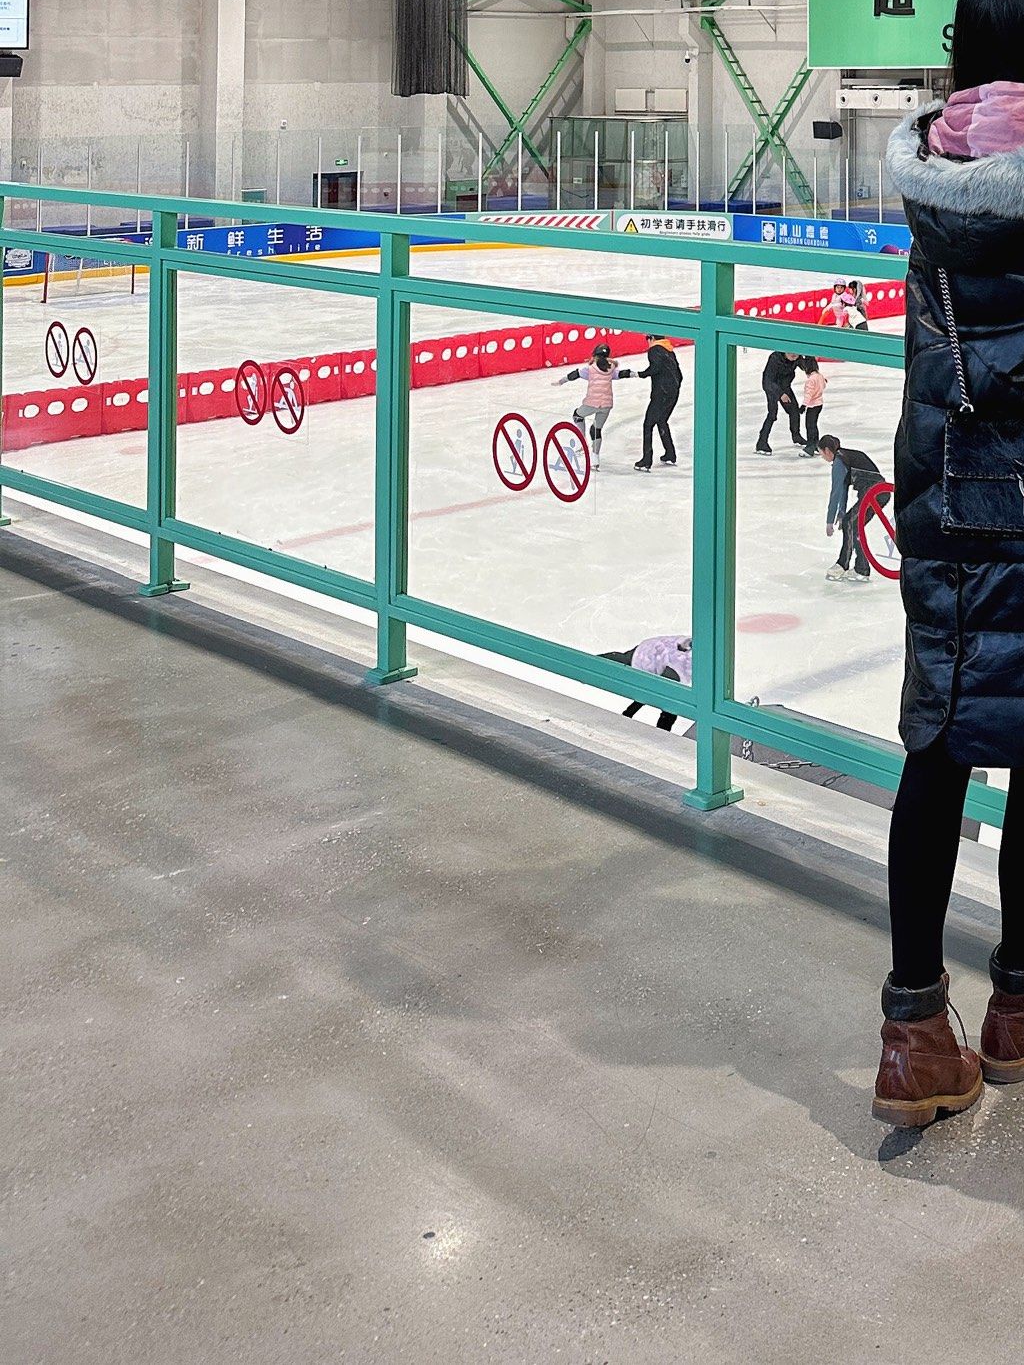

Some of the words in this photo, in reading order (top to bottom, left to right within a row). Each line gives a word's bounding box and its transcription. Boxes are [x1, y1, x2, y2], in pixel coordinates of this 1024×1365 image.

[640, 217, 726, 232] 初学者请手扶滑行
[289, 242, 321, 253] life
